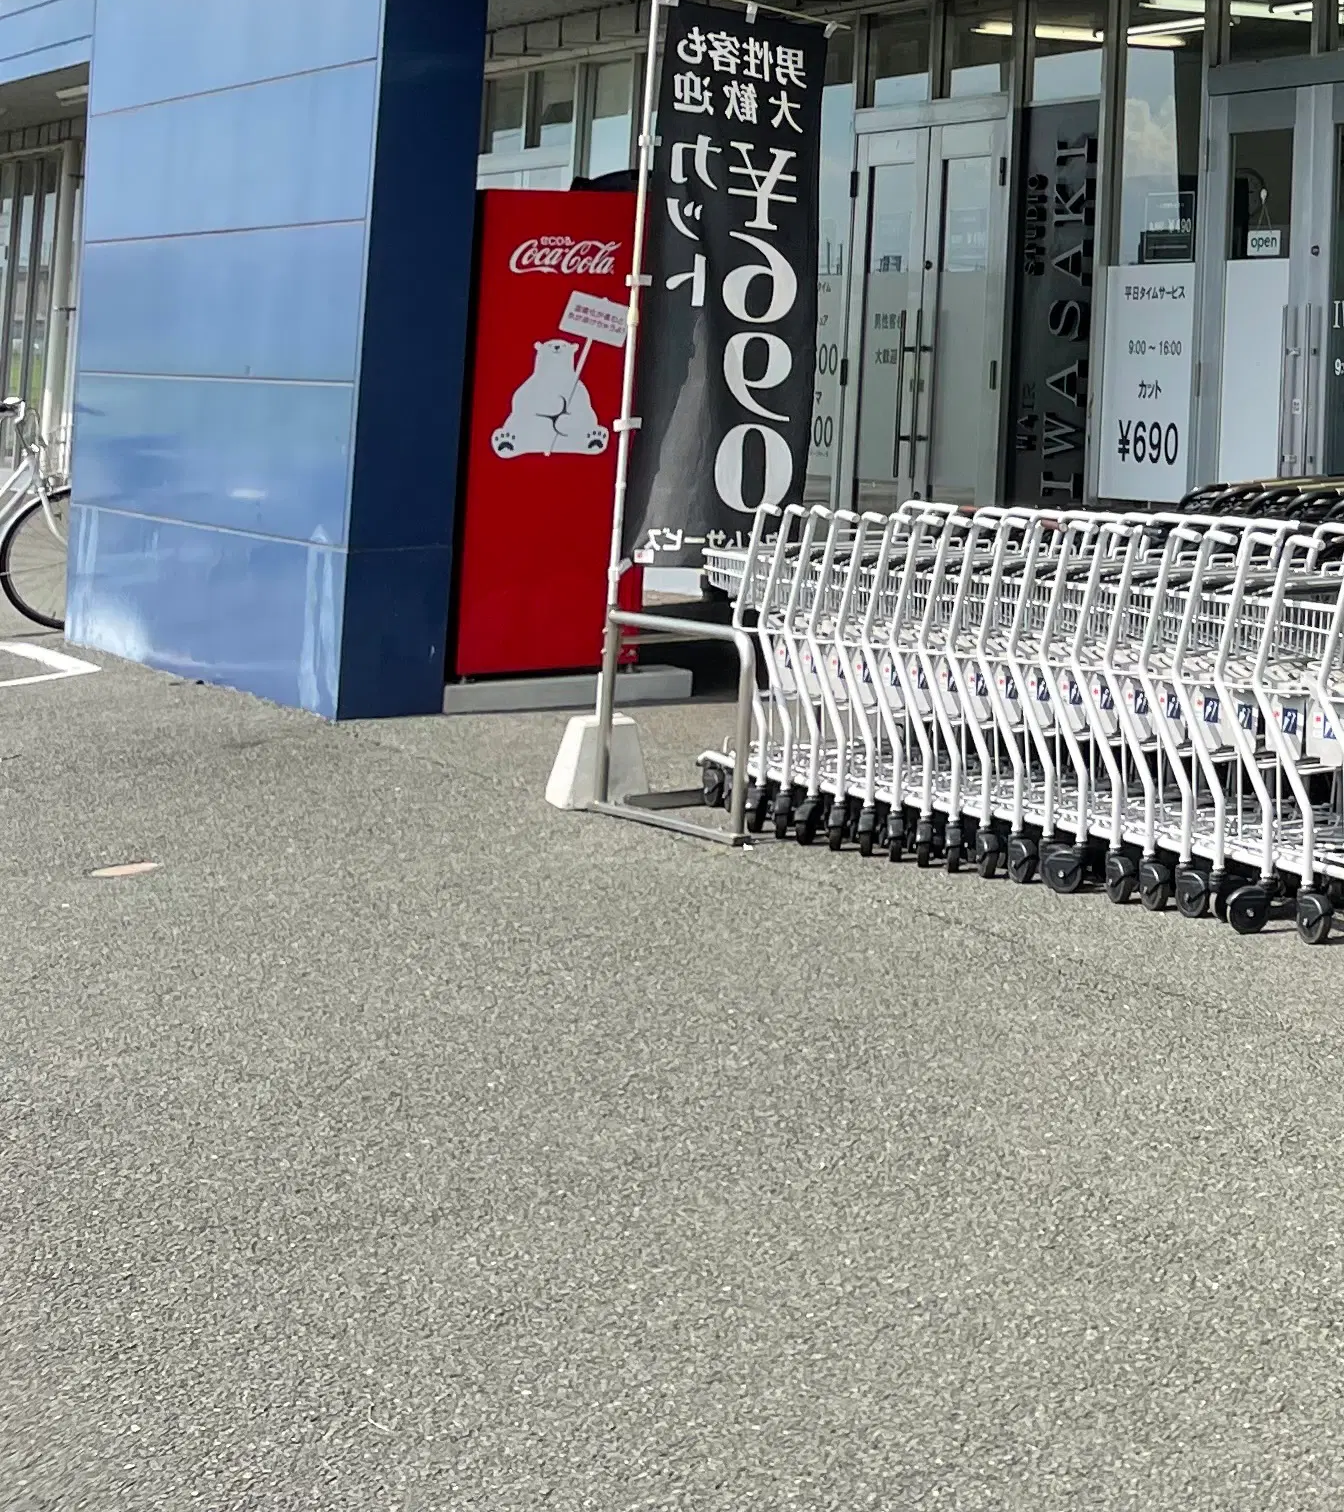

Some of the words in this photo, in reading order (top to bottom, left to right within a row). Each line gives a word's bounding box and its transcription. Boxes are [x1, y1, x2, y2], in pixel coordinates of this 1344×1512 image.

[1250, 236, 1277, 252] open
[1041, 138, 1096, 497] IWASAKI
[1138, 379, 1162, 399] カット
[1118, 419, 1179, 465] ¥690
